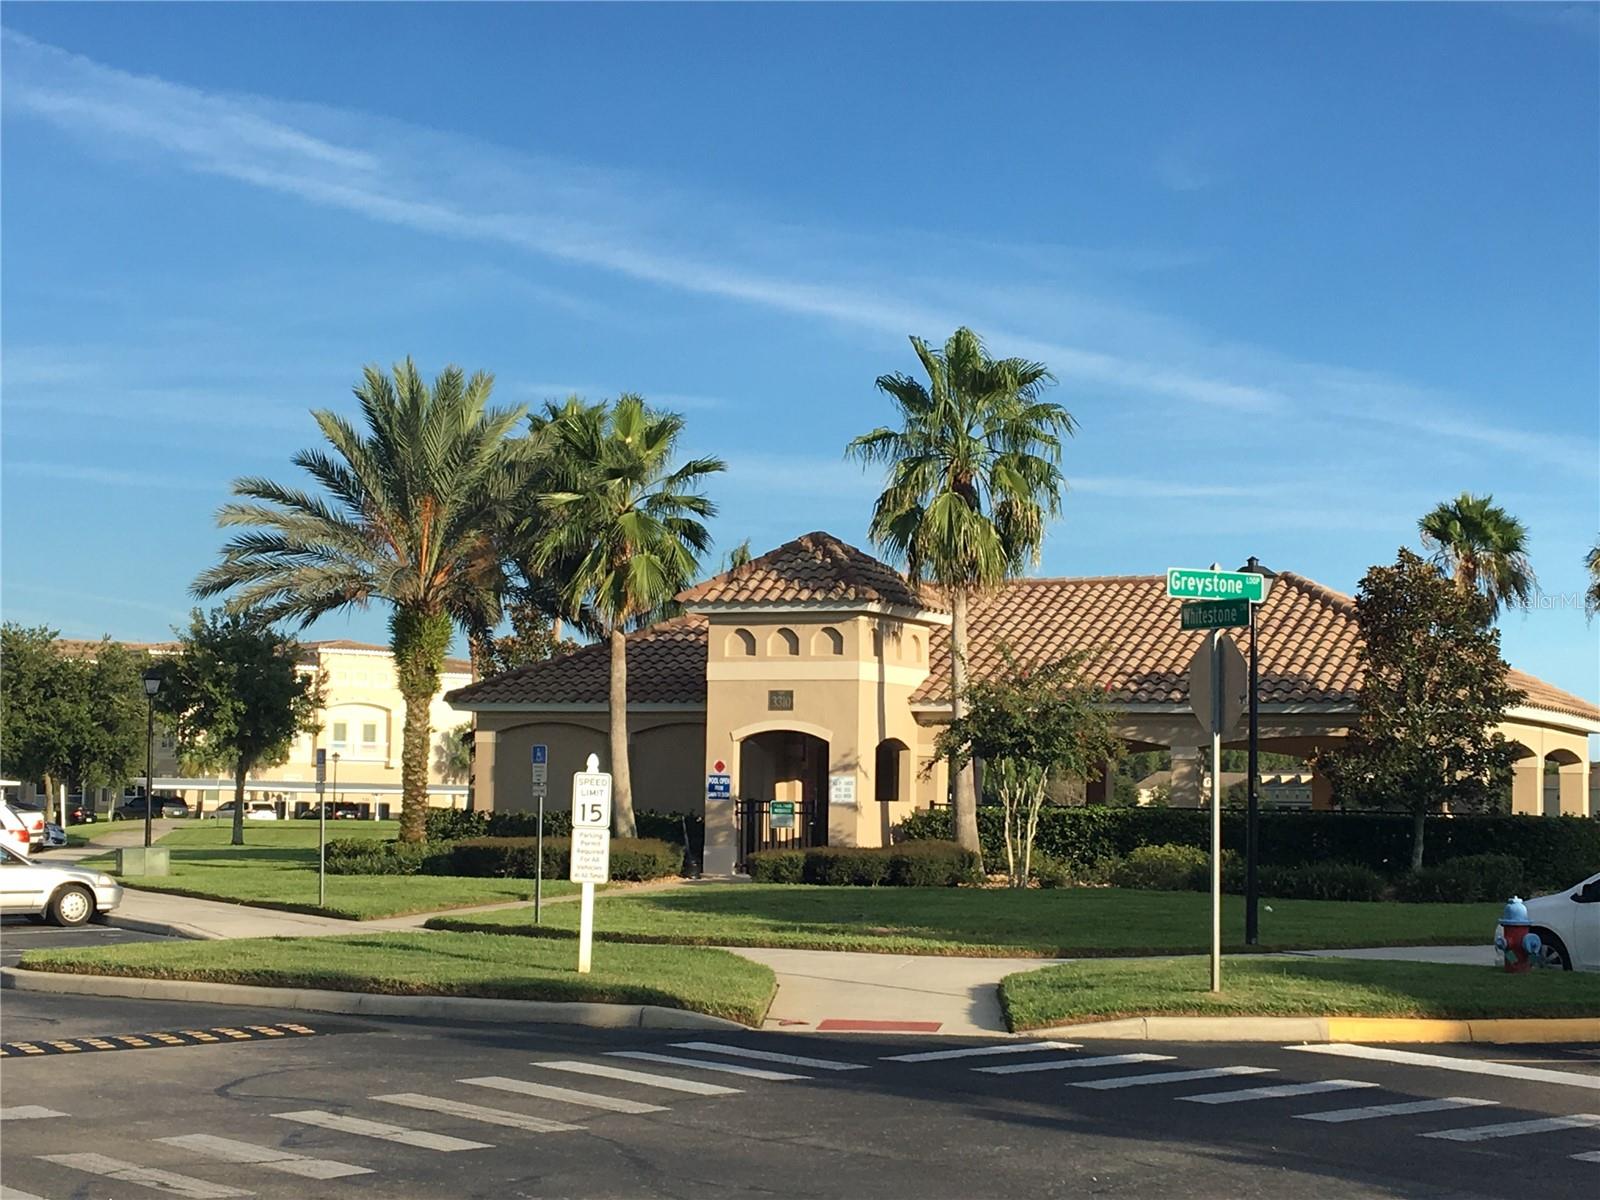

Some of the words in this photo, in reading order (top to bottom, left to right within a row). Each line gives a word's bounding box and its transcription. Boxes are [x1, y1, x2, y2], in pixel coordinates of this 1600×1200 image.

[1171, 572, 1243, 595] Greystone
[1183, 607, 1237, 624] Whitestone
[578, 778, 607, 786] SPEED
[581, 803, 602, 822] 15
[579, 832, 603, 840] Parking
